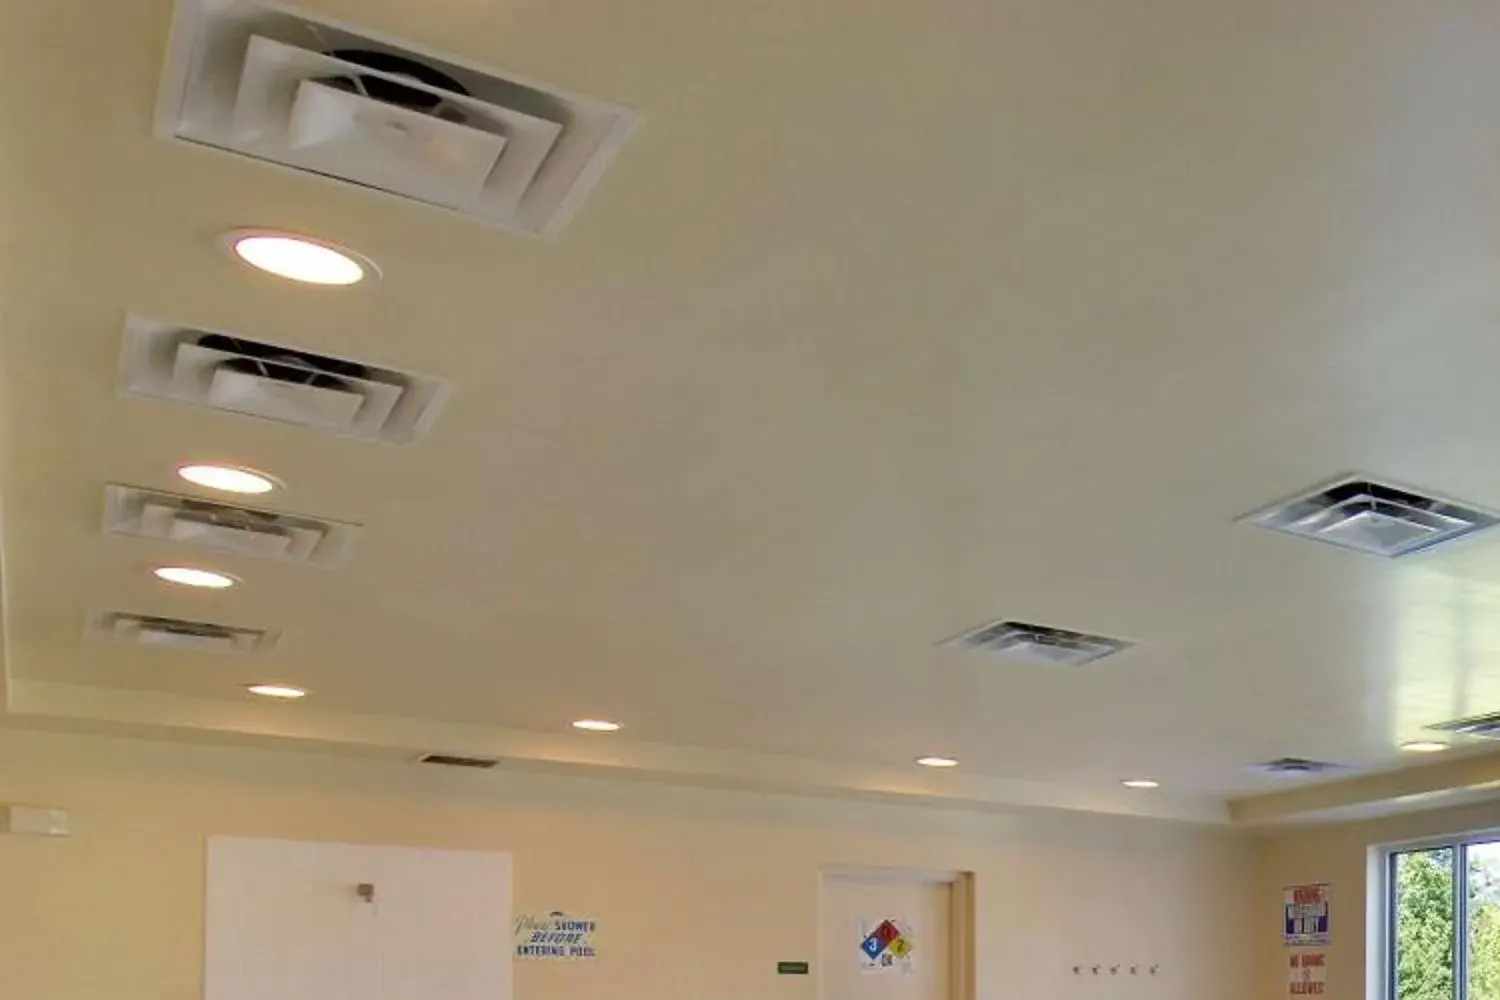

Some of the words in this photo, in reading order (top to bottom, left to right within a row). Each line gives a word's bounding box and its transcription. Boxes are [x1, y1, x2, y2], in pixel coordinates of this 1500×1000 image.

[530, 931, 583, 943] BEFORE
[517, 945, 565, 956] ENTERING
[569, 945, 596, 956] POOL
